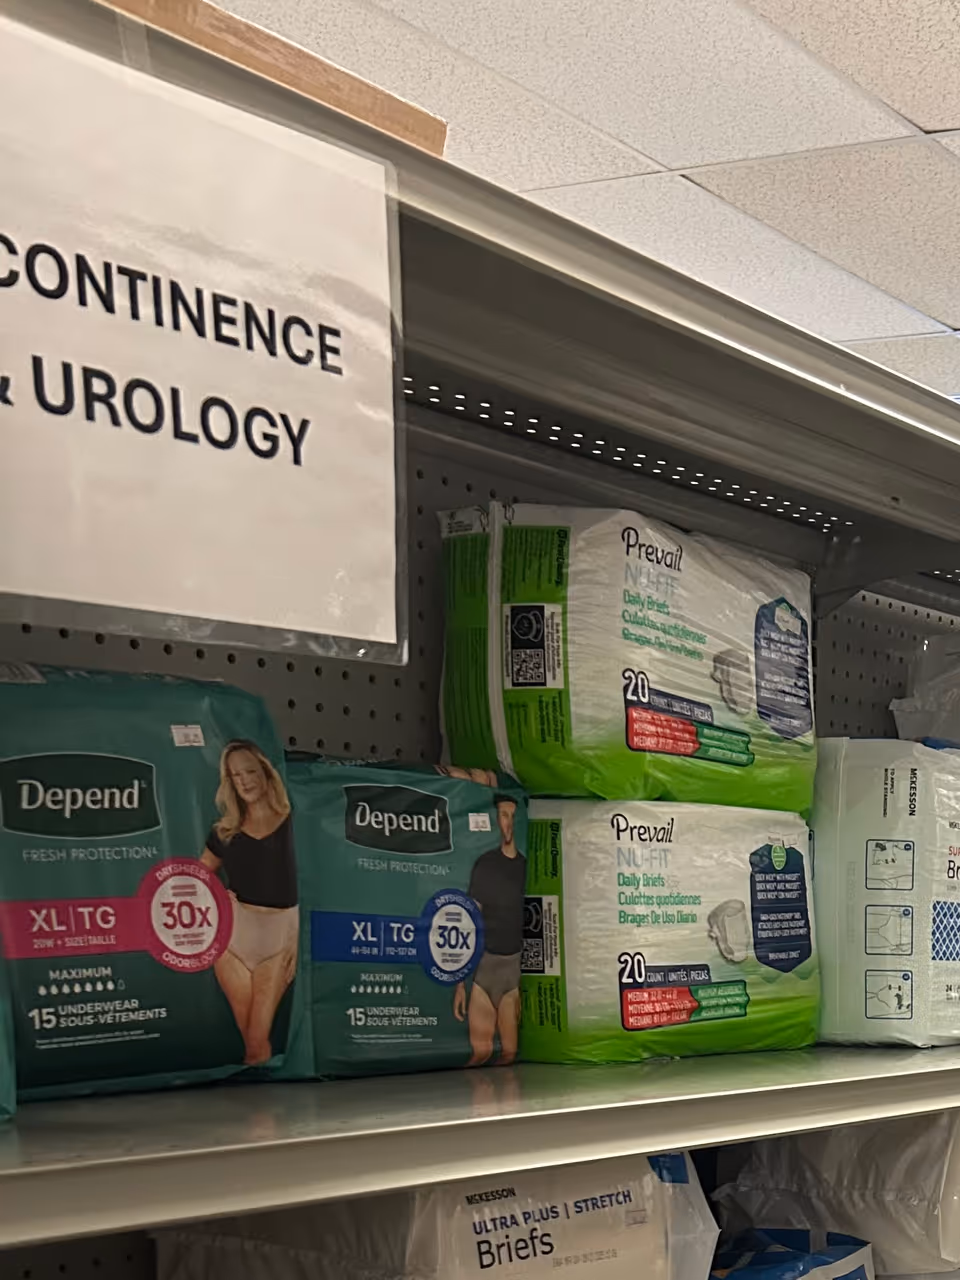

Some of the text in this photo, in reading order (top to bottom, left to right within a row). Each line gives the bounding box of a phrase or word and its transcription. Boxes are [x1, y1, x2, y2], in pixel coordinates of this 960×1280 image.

[31, 354, 310, 466] UROLOGY
[621, 526, 683, 573] Prevail
[624, 670, 649, 704] 20
[17, 778, 141, 819] Depend
[354, 801, 441, 837] Depend
[610, 812, 675, 843] Prevail
[22, 845, 151, 862] FRESH PROTECTION
[358, 858, 387, 872] FRESH
[616, 846, 672, 868] NU-FIT
[617, 871, 665, 890] Daily Briefs
[618, 891, 702, 909] Culottes quotidiennes
[28, 906, 117, 933] XL TG
[351, 920, 415, 944] XL TG
[48, 967, 113, 981] MAXIMUM
[621, 954, 646, 983] 20
[28, 998, 140, 1030] 15 UNDERWEAR
[345, 1005, 420, 1027] 15 UNDERWEAR
[472, 1189, 633, 1236] ULTRA PLUS STRETCH
[476, 1227, 555, 1270] Briefs
